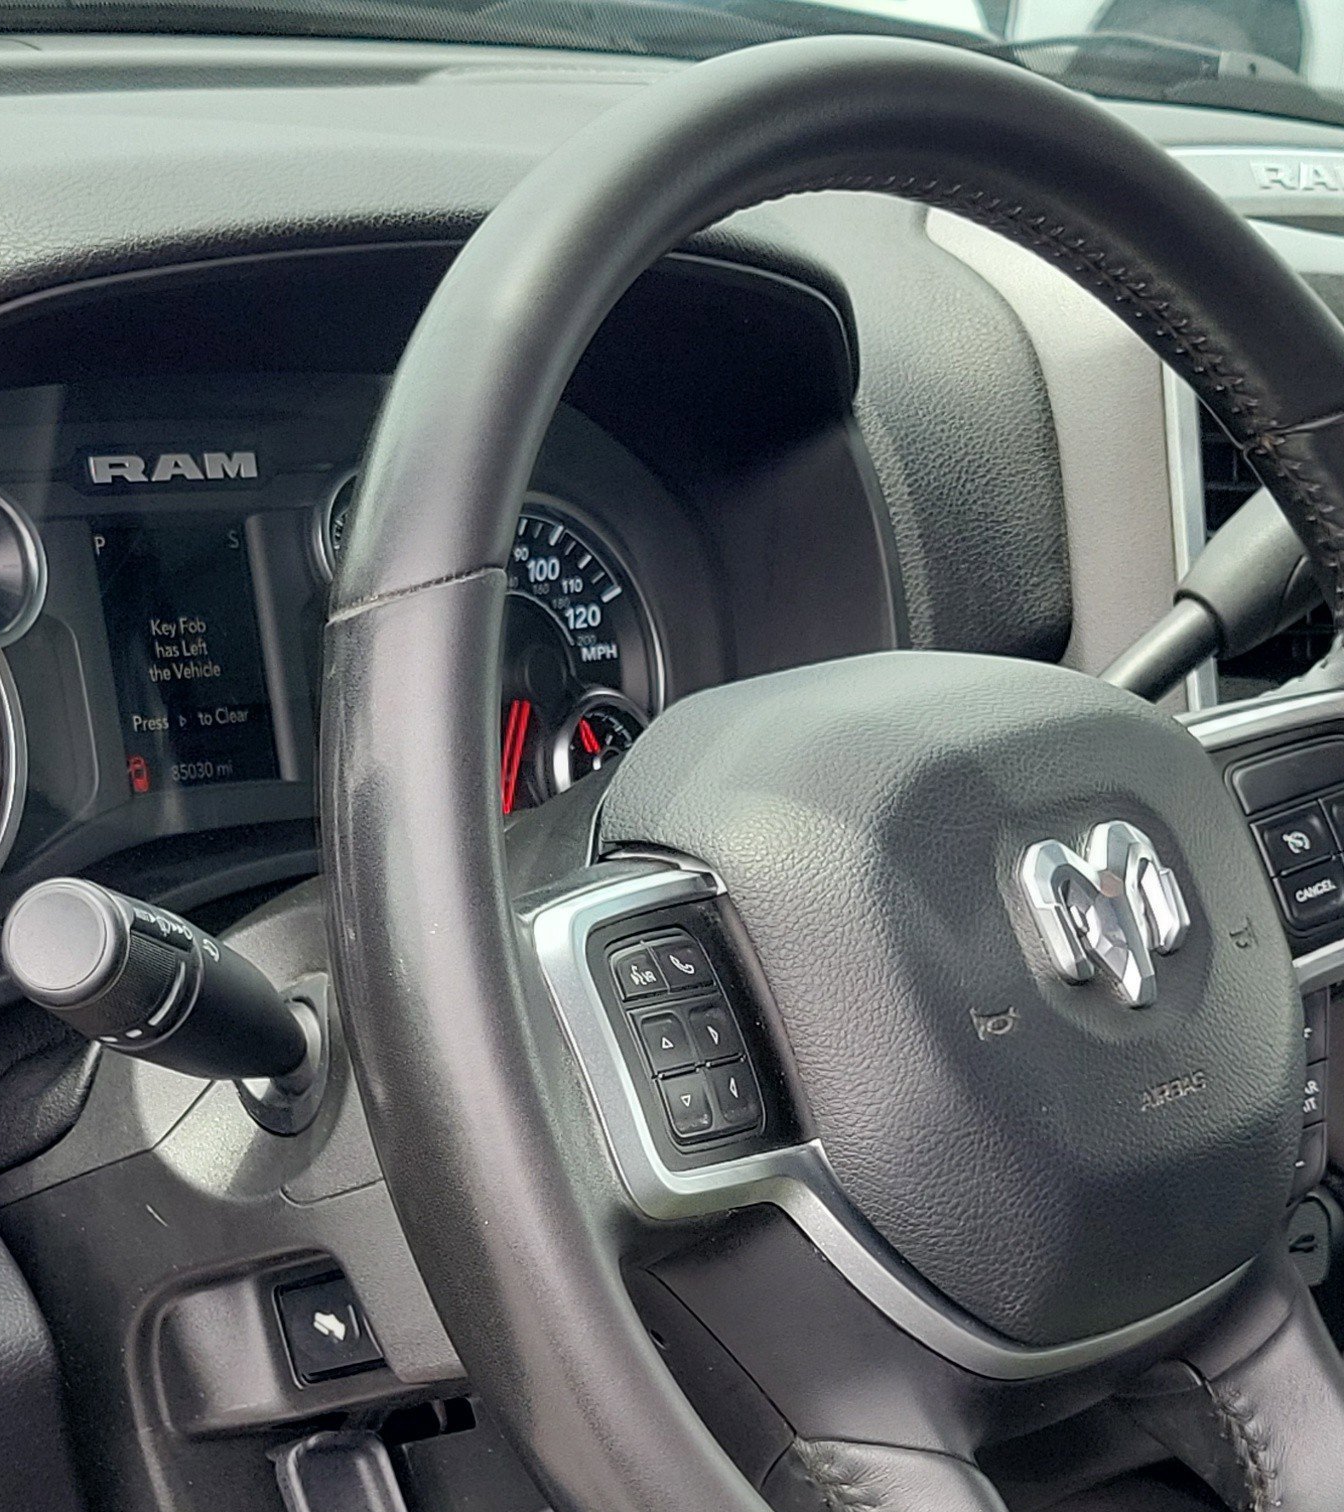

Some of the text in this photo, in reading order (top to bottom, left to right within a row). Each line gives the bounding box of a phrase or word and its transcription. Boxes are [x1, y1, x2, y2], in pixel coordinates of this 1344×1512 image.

[88, 453, 257, 484] RAM
[94, 530, 239, 556] P S
[514, 547, 529, 562] 90
[526, 557, 560, 583] 100
[561, 575, 583, 594] 110
[150, 617, 207, 638] Key Fob
[564, 603, 601, 630] 120
[155, 639, 208, 658] has Left
[581, 644, 618, 662] MPH
[149, 661, 222, 682] the Vehicle
[132, 707, 249, 732] Press to Clear
[171, 760, 234, 782] 85030 mi
[1295, 879, 1337, 902] CANCEL
[1141, 1070, 1207, 1111] AIRBAG
